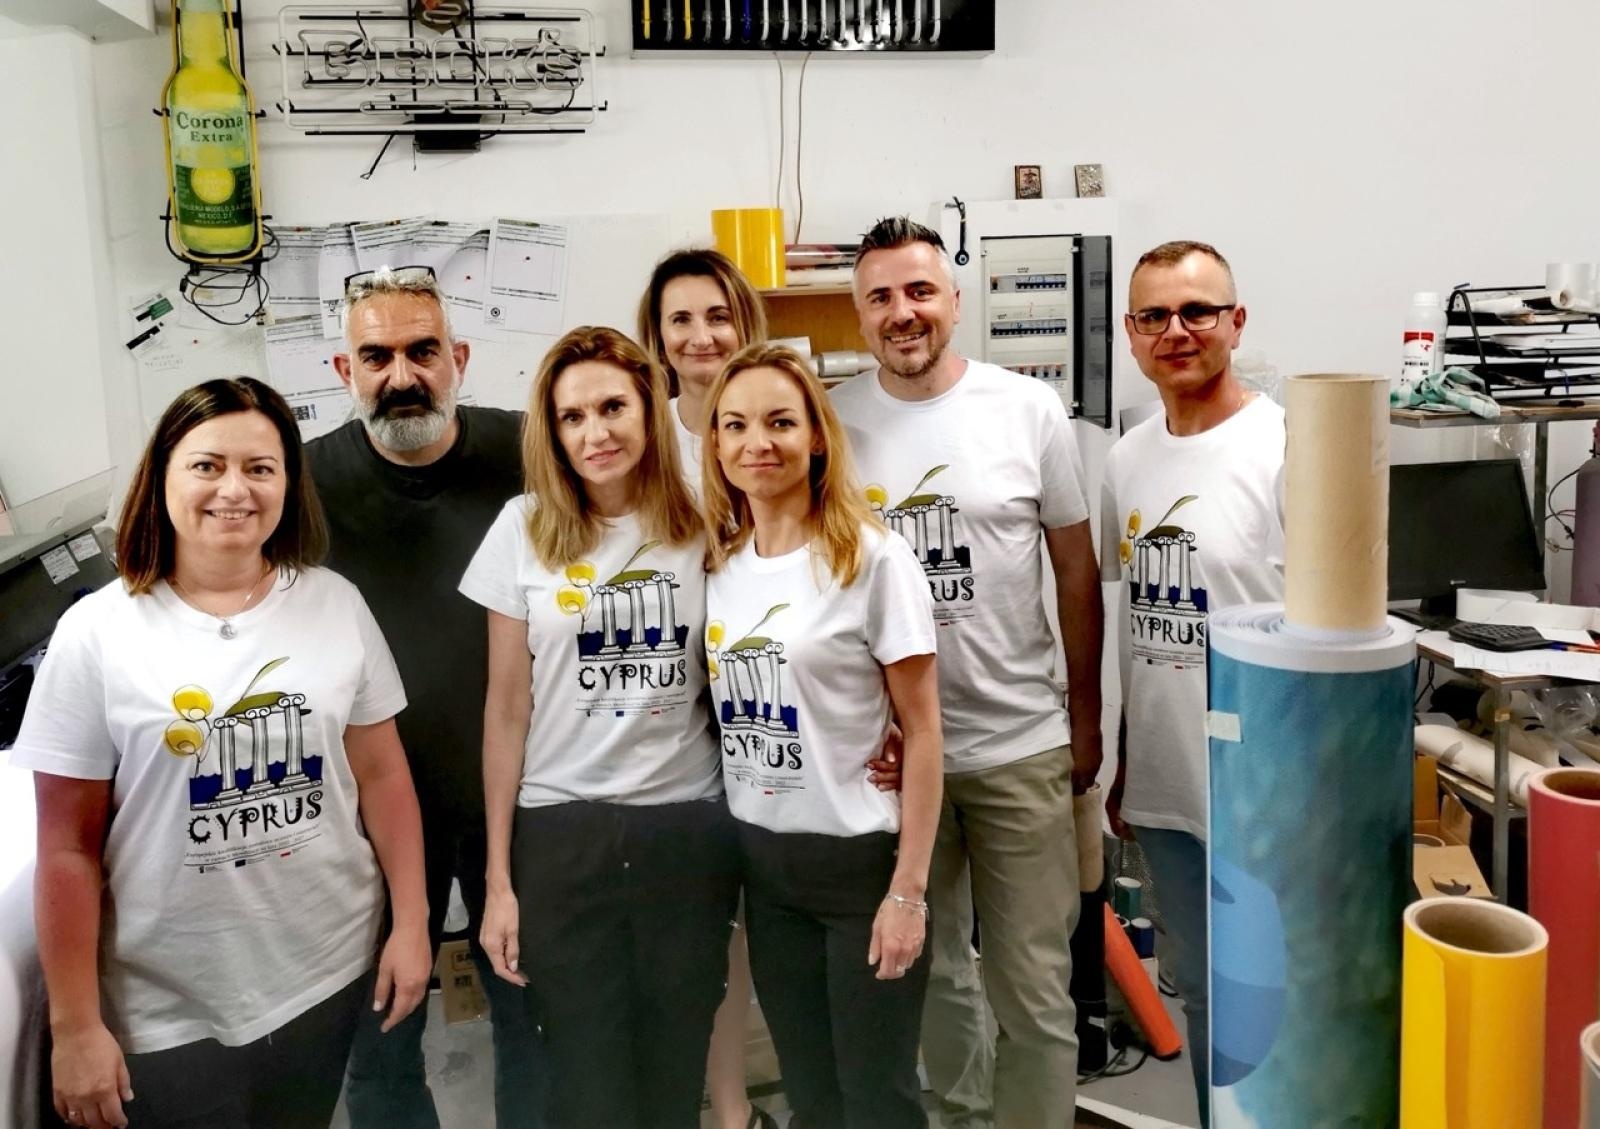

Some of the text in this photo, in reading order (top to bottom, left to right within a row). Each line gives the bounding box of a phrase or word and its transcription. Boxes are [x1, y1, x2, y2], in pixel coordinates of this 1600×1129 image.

[176, 111, 243, 130] Corona
[190, 131, 233, 142] Extra
[578, 658, 686, 691] CYPRUS
[723, 732, 802, 770] CYPRUS
[187, 790, 323, 845] CYPRUS
